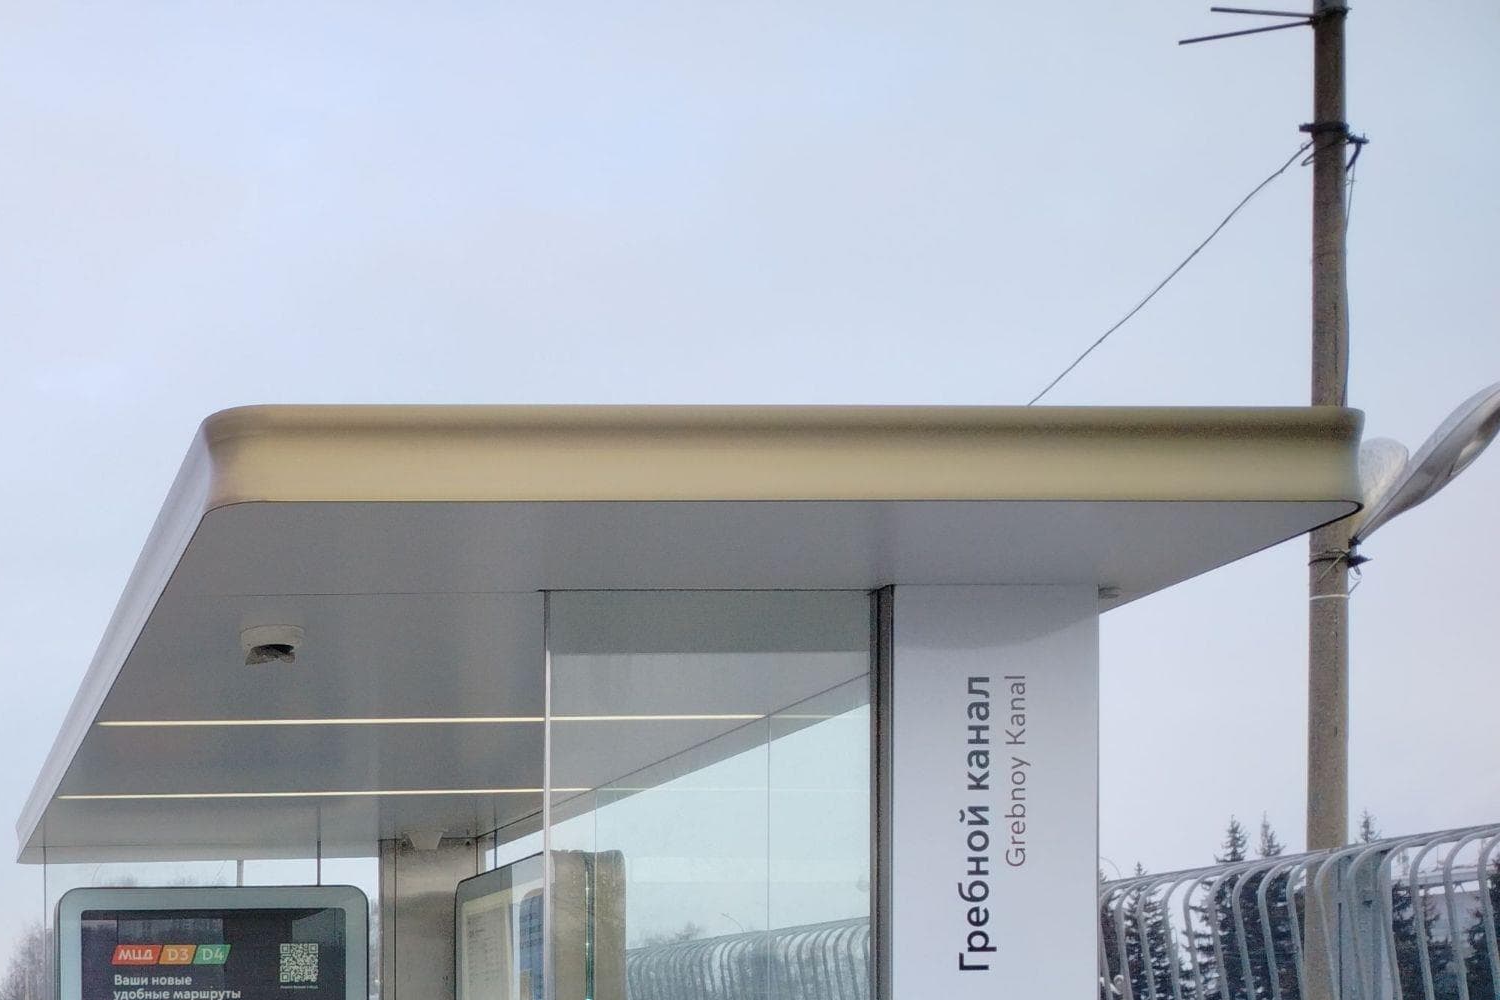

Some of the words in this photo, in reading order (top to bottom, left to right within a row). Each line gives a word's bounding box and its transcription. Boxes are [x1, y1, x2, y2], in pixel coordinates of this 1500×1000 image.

[966, 676, 990, 791] канал
[1004, 675, 1026, 745] Kanal
[1004, 756, 1031, 867] Grebnoy
[958, 805, 998, 971] Гребной
[114, 974, 149, 986] Ваши
[151, 975, 193, 986] новые
[118, 949, 153, 960] МЦД
[167, 948, 189, 960] D3
[202, 948, 224, 960] D4
[113, 988, 170, 1000] удобные
[172, 989, 242, 1000] маршруты
